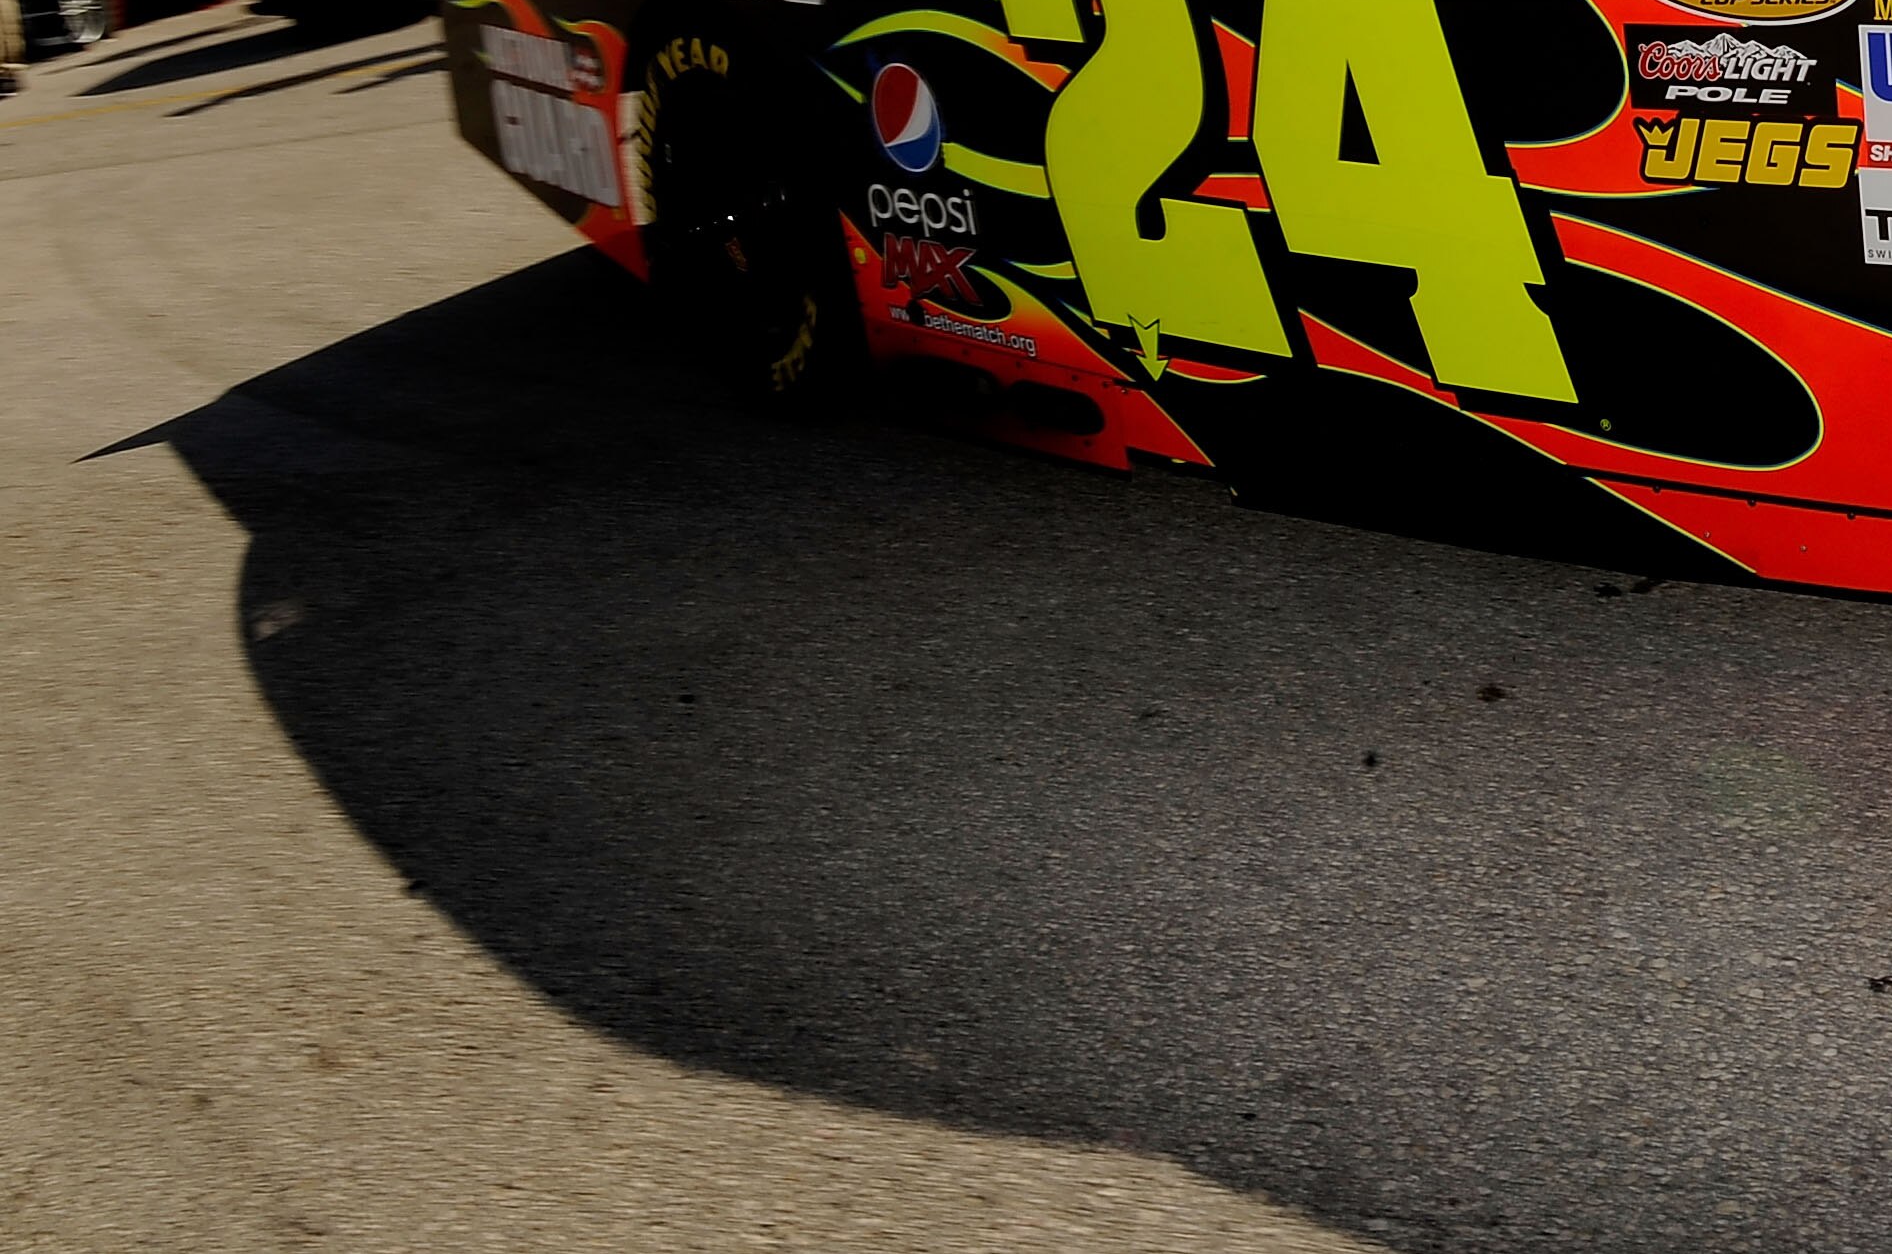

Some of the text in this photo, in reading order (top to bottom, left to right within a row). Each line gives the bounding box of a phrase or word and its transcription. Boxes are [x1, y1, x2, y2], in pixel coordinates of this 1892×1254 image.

[1637, 41, 1818, 83] Coors LIGHT
[1664, 85, 1793, 104] POLE
[1644, 117, 1858, 189] JEGS
[867, 183, 977, 237] pepsi
[881, 232, 985, 307] MAX
